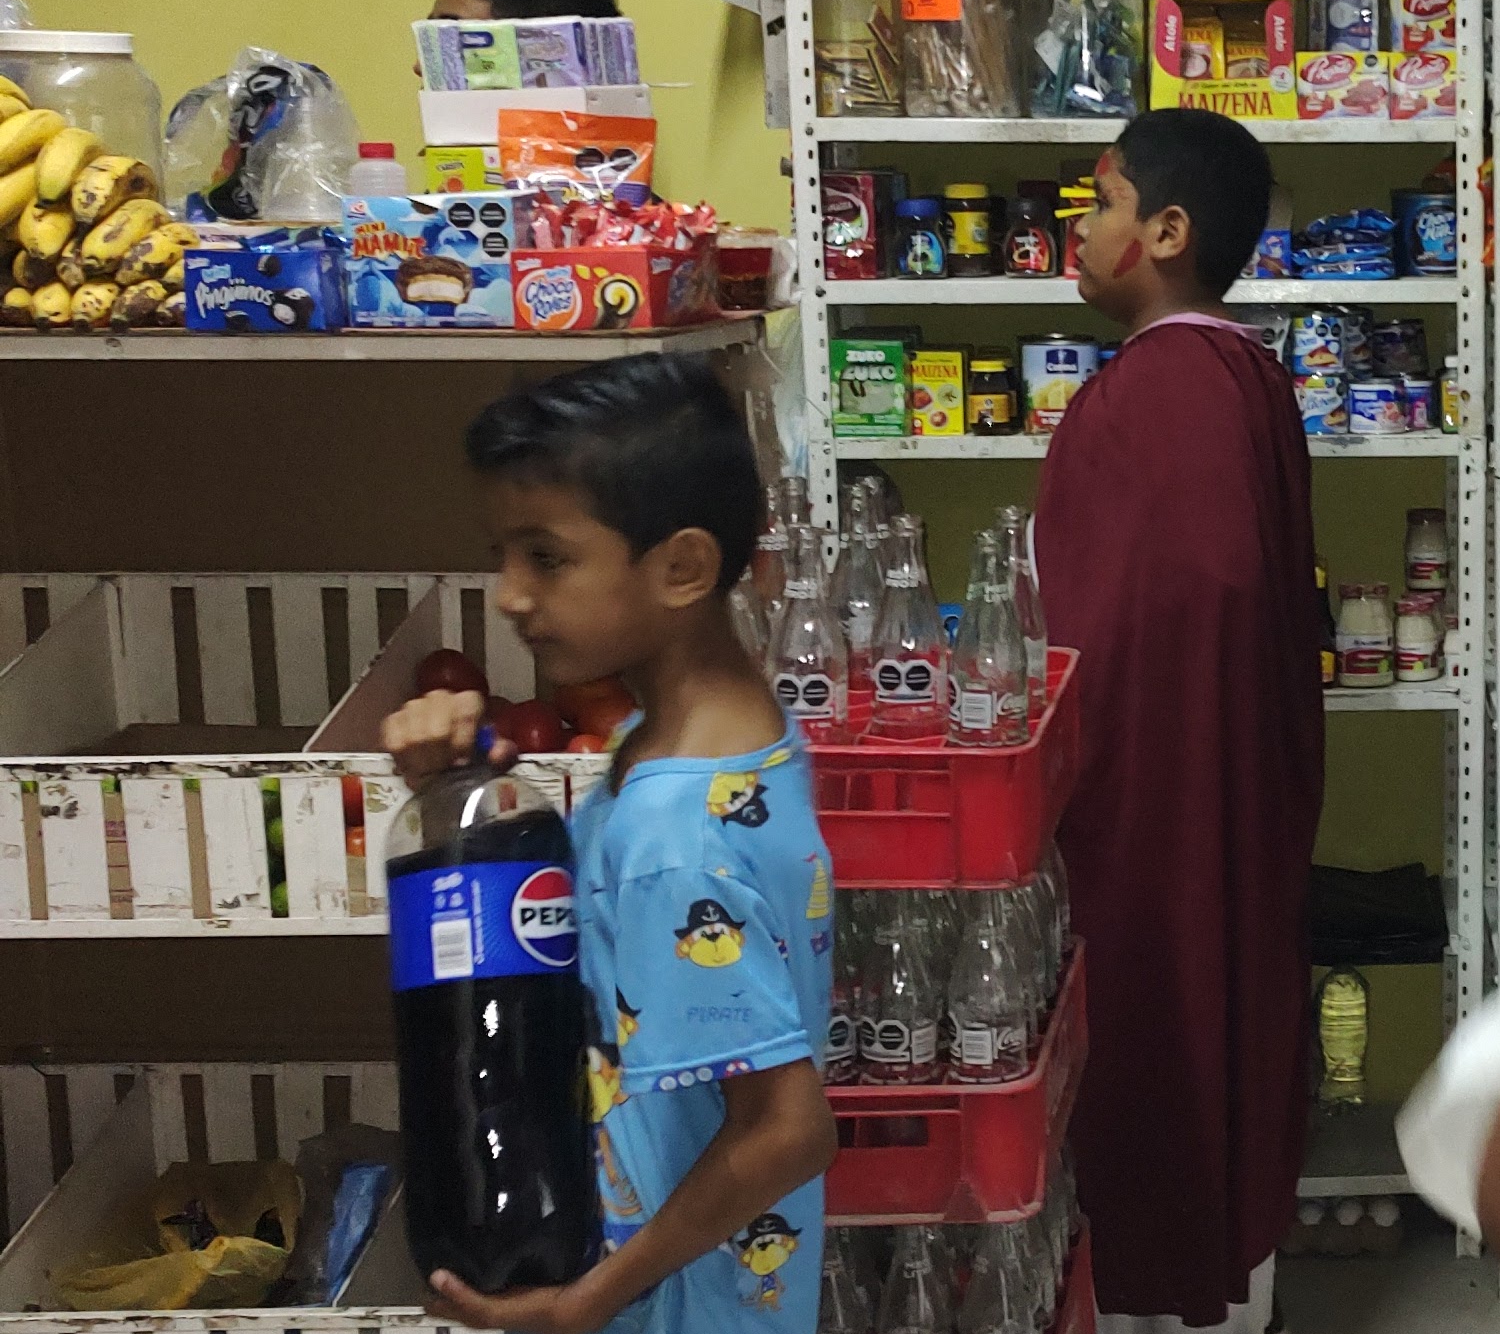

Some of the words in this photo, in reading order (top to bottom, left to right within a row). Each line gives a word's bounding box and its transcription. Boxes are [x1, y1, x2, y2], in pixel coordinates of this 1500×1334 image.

[1164, 14, 1178, 53] Atole
[1271, 14, 1287, 53] Atole
[1178, 91, 1274, 116] MAIZENA
[354, 221, 387, 235] MINI
[352, 232, 428, 260] MAMUT
[525, 278, 575, 304] Choco
[845, 349, 887, 363] ZUKO
[842, 363, 898, 382] ZUKO
